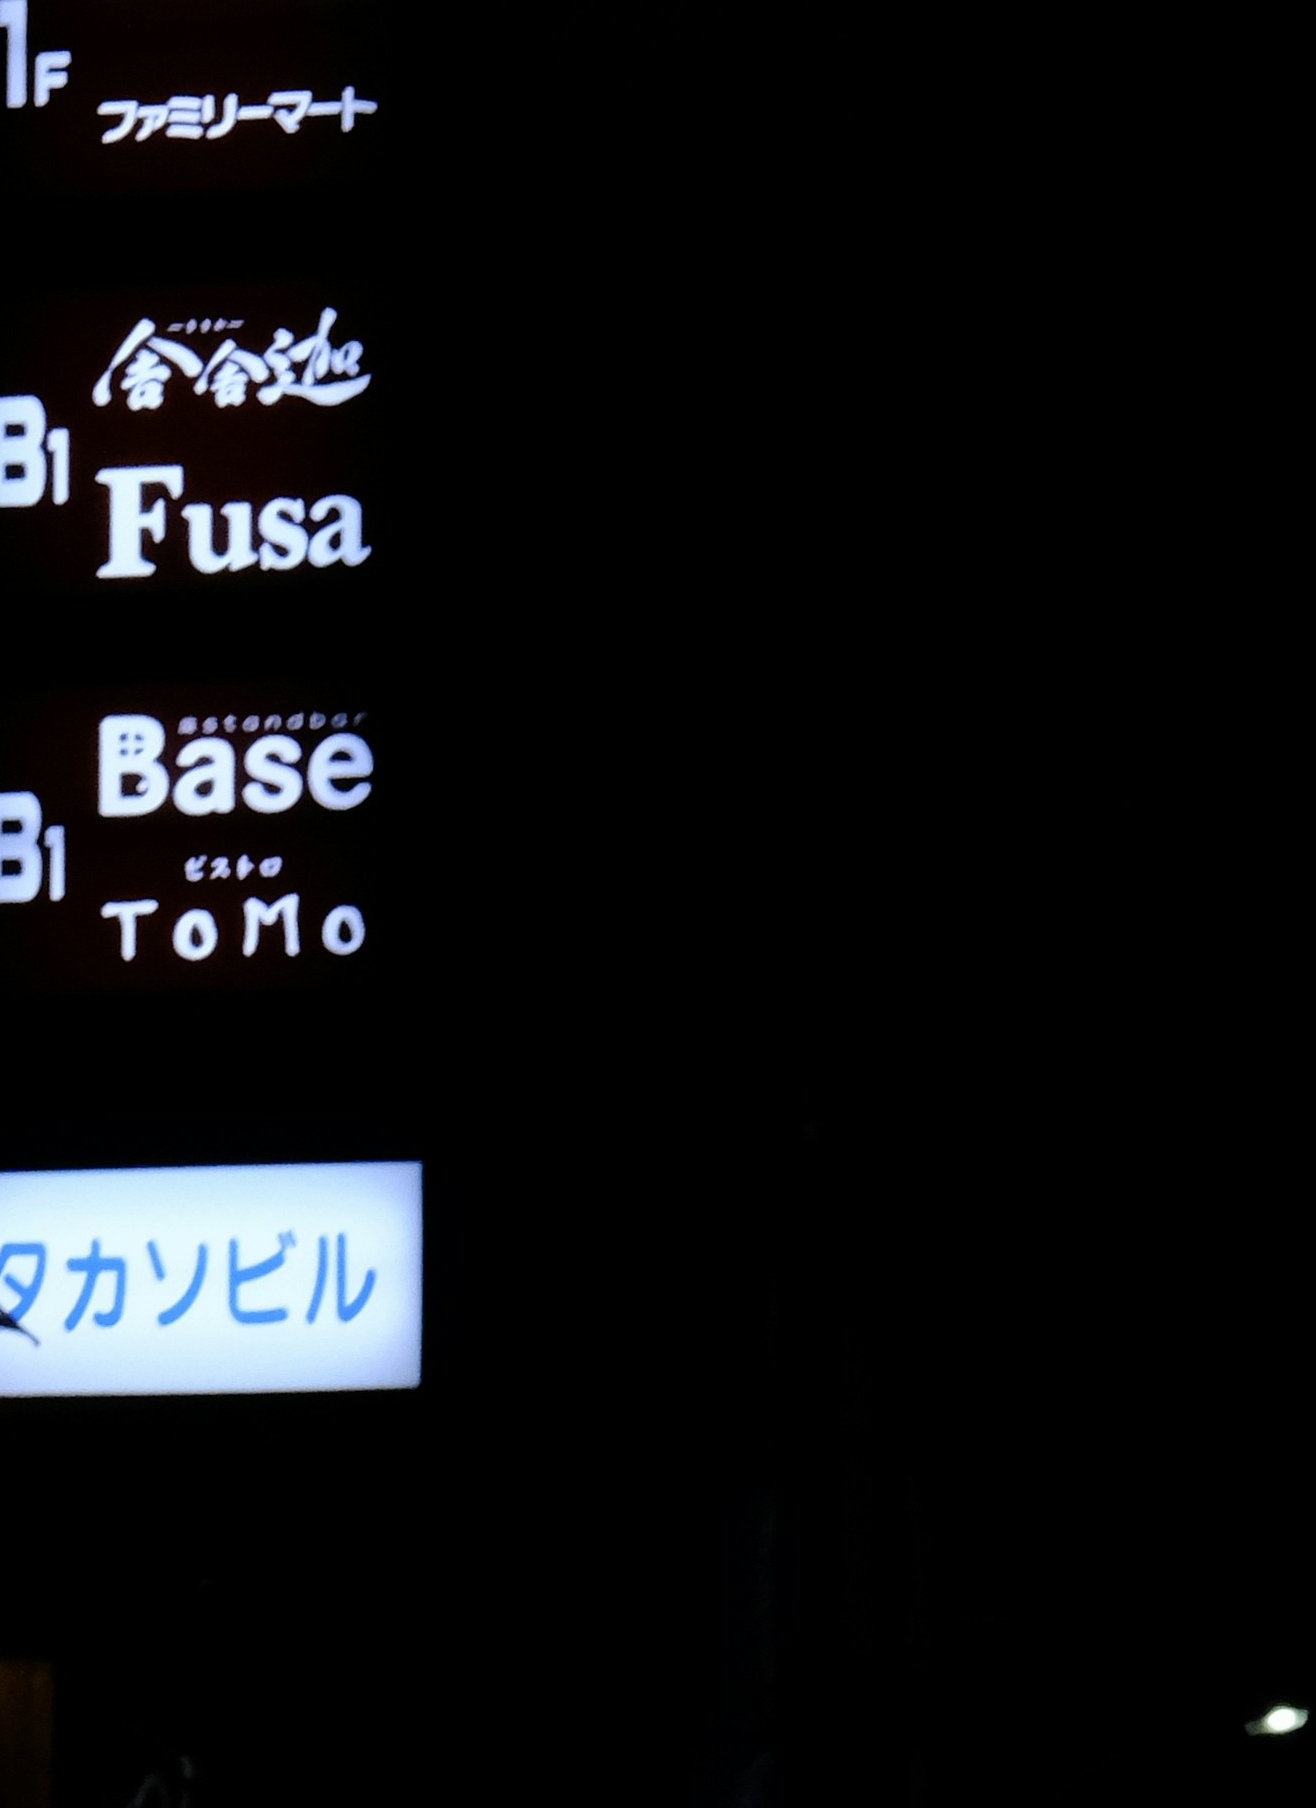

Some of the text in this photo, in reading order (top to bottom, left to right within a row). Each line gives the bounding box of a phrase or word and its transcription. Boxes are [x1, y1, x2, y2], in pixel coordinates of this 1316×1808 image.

[96, 85, 378, 144] ファミリーマート
[95, 464, 372, 579] Fusa
[98, 712, 375, 818] Base
[184, 852, 284, 883] ビストロ
